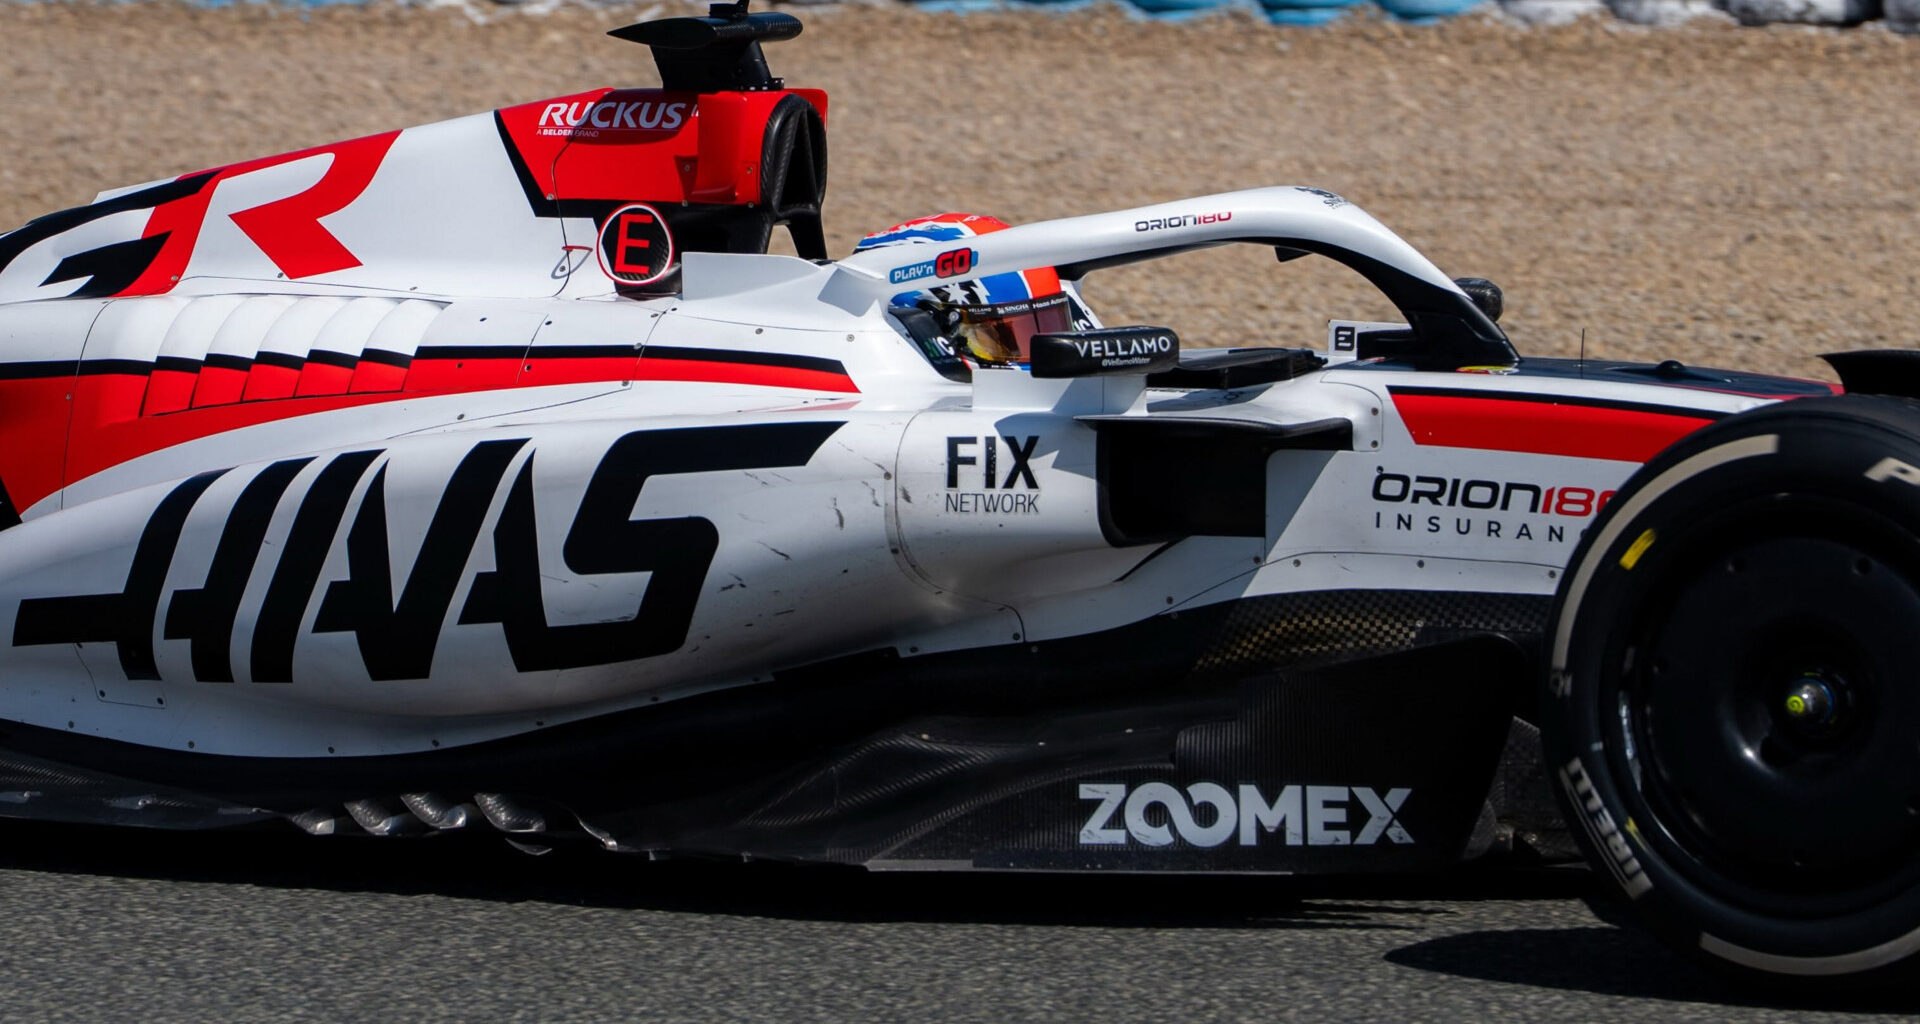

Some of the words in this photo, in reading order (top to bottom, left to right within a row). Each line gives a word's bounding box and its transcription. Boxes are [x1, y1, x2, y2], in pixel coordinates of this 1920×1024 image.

[538, 102, 686, 128] RUCKUS
[574, 130, 599, 138] BRAND
[1135, 212, 1232, 232] ORION180
[613, 213, 654, 275] E
[894, 264, 934, 282] PLAY'n
[936, 247, 972, 278] GO
[1005, 303, 1029, 312] SINGHA
[1075, 336, 1171, 357] VELLAMO
[1101, 357, 1151, 367] @VellamoWater
[947, 436, 1040, 489] FIX
[945, 493, 1039, 513] NETWORK
[1375, 511, 1592, 543] INSURAN
[12, 421, 848, 683] HAAS
[1078, 782, 1415, 847] ZOOMEX
